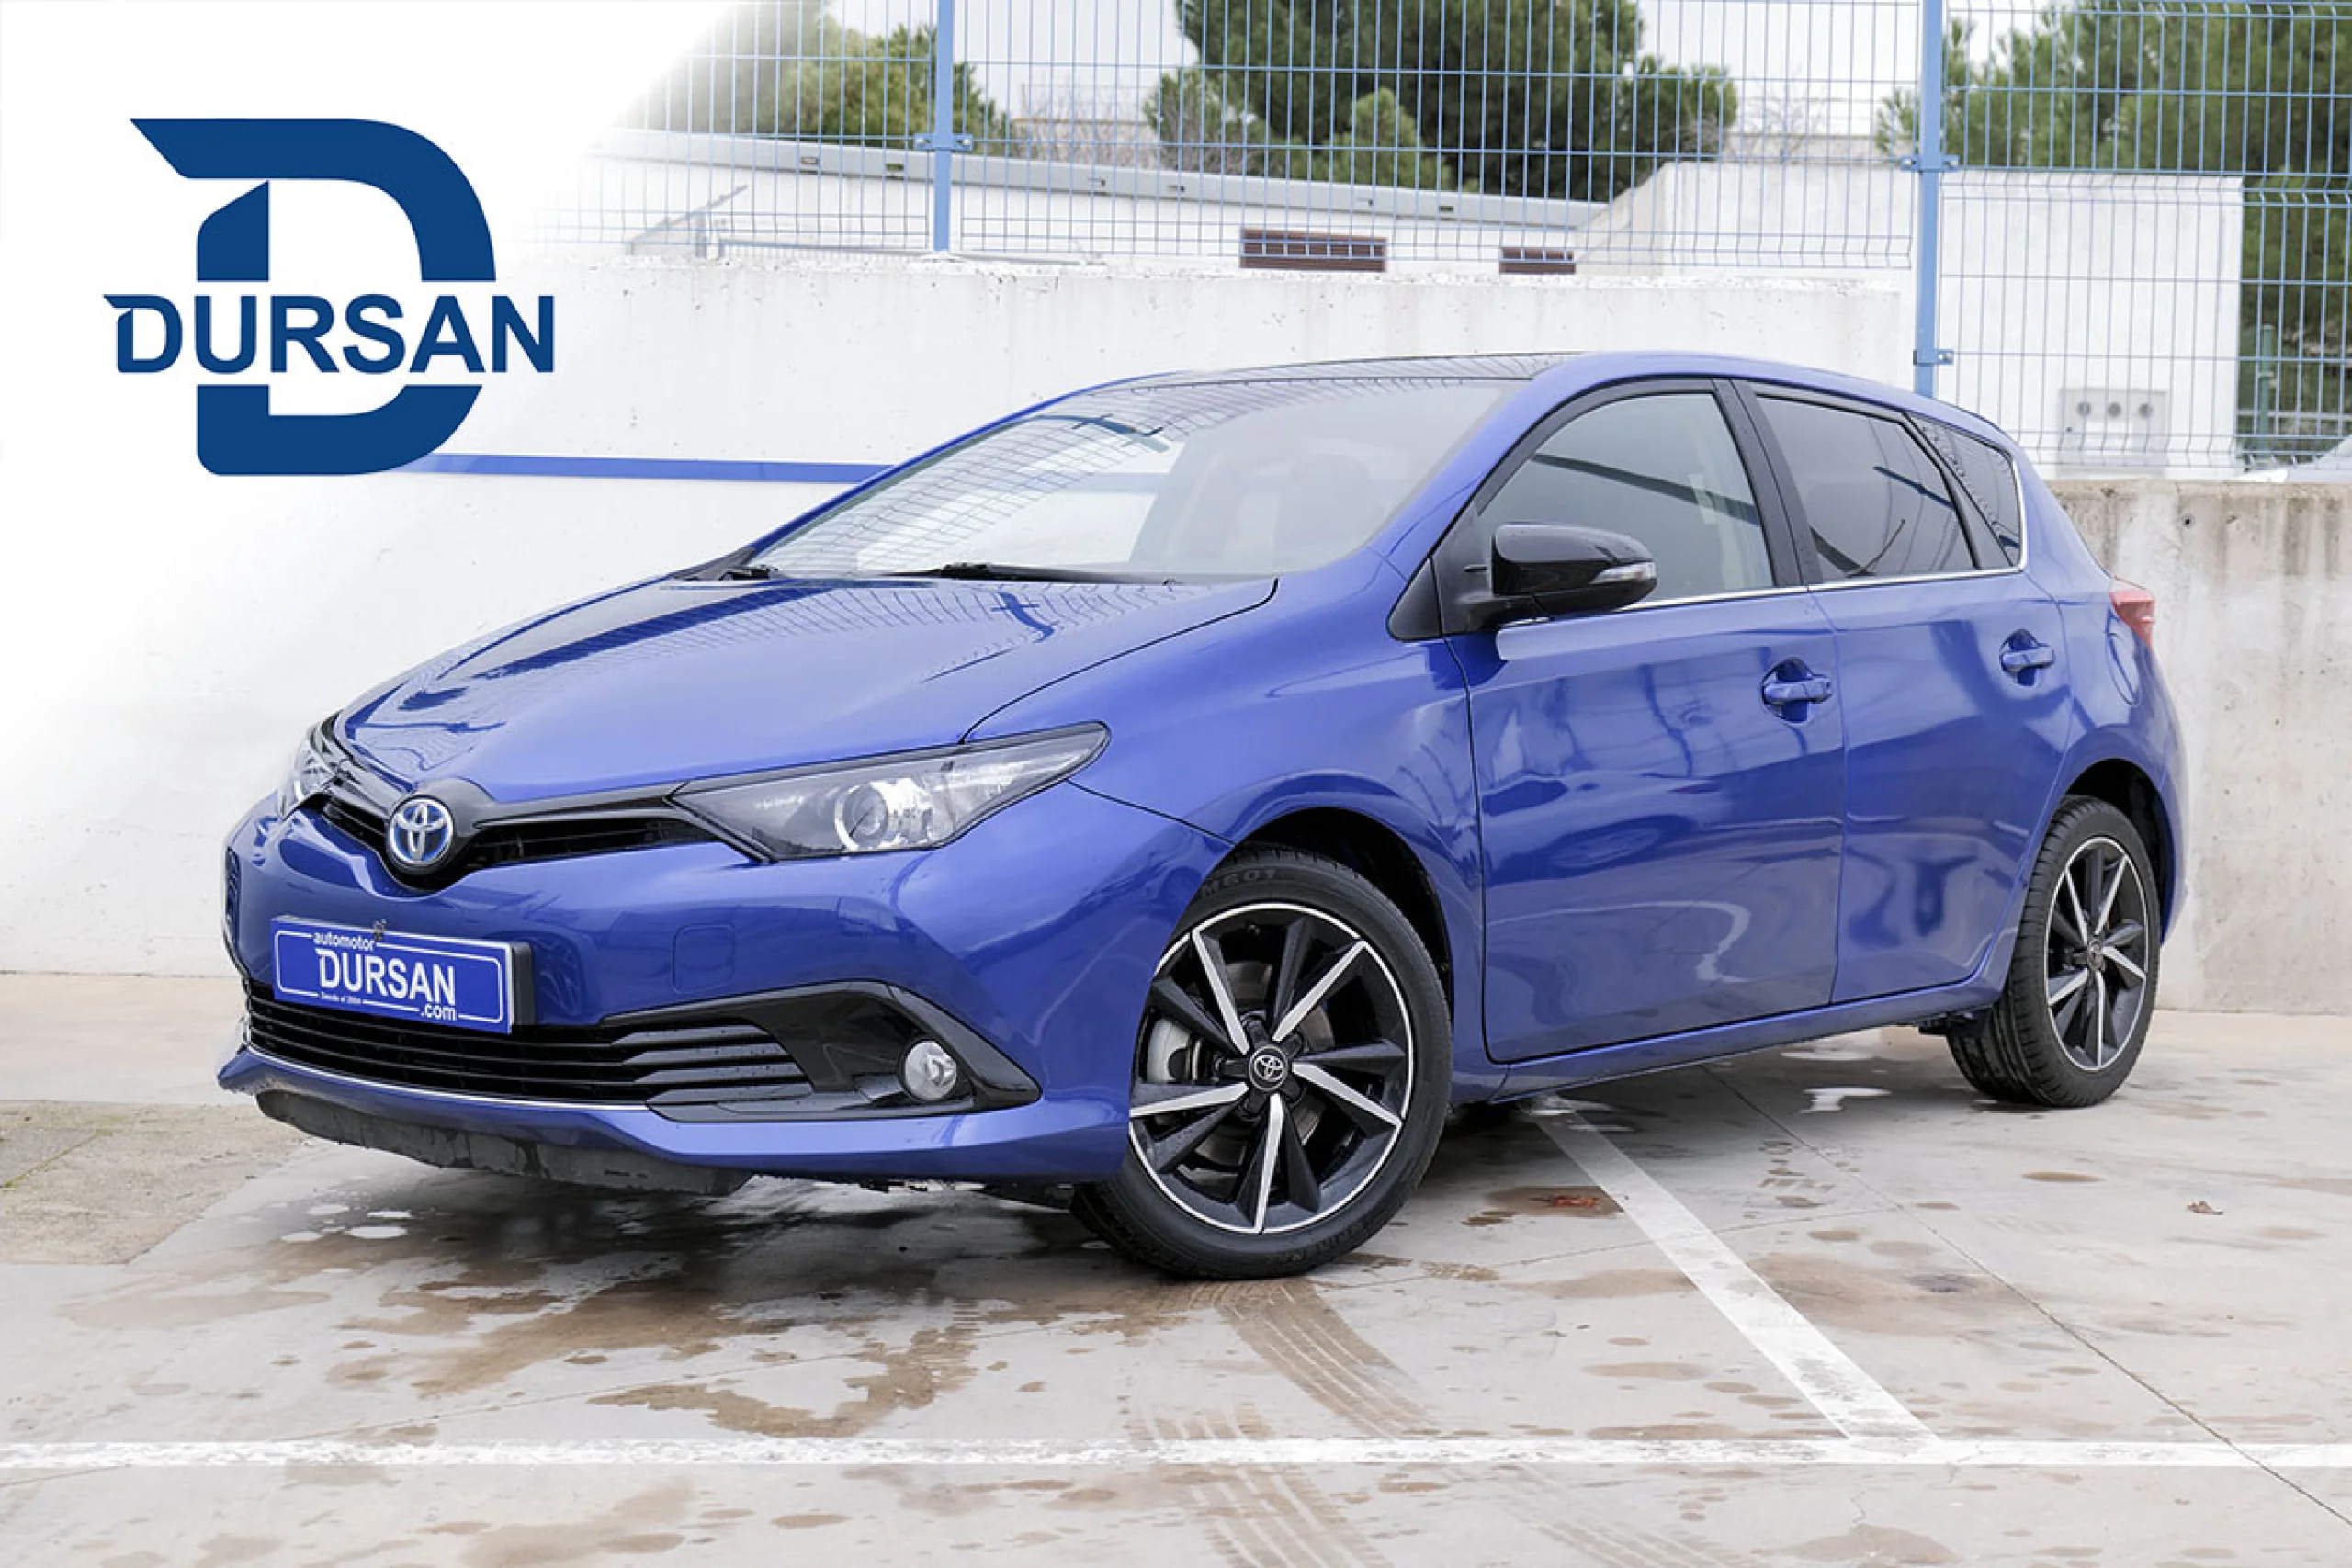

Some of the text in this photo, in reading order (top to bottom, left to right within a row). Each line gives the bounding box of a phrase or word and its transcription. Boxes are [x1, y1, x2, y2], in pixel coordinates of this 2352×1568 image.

[312, 931, 376, 952] automotor
[314, 948, 456, 1006] DURSAN
[420, 1003, 458, 1021] .com
